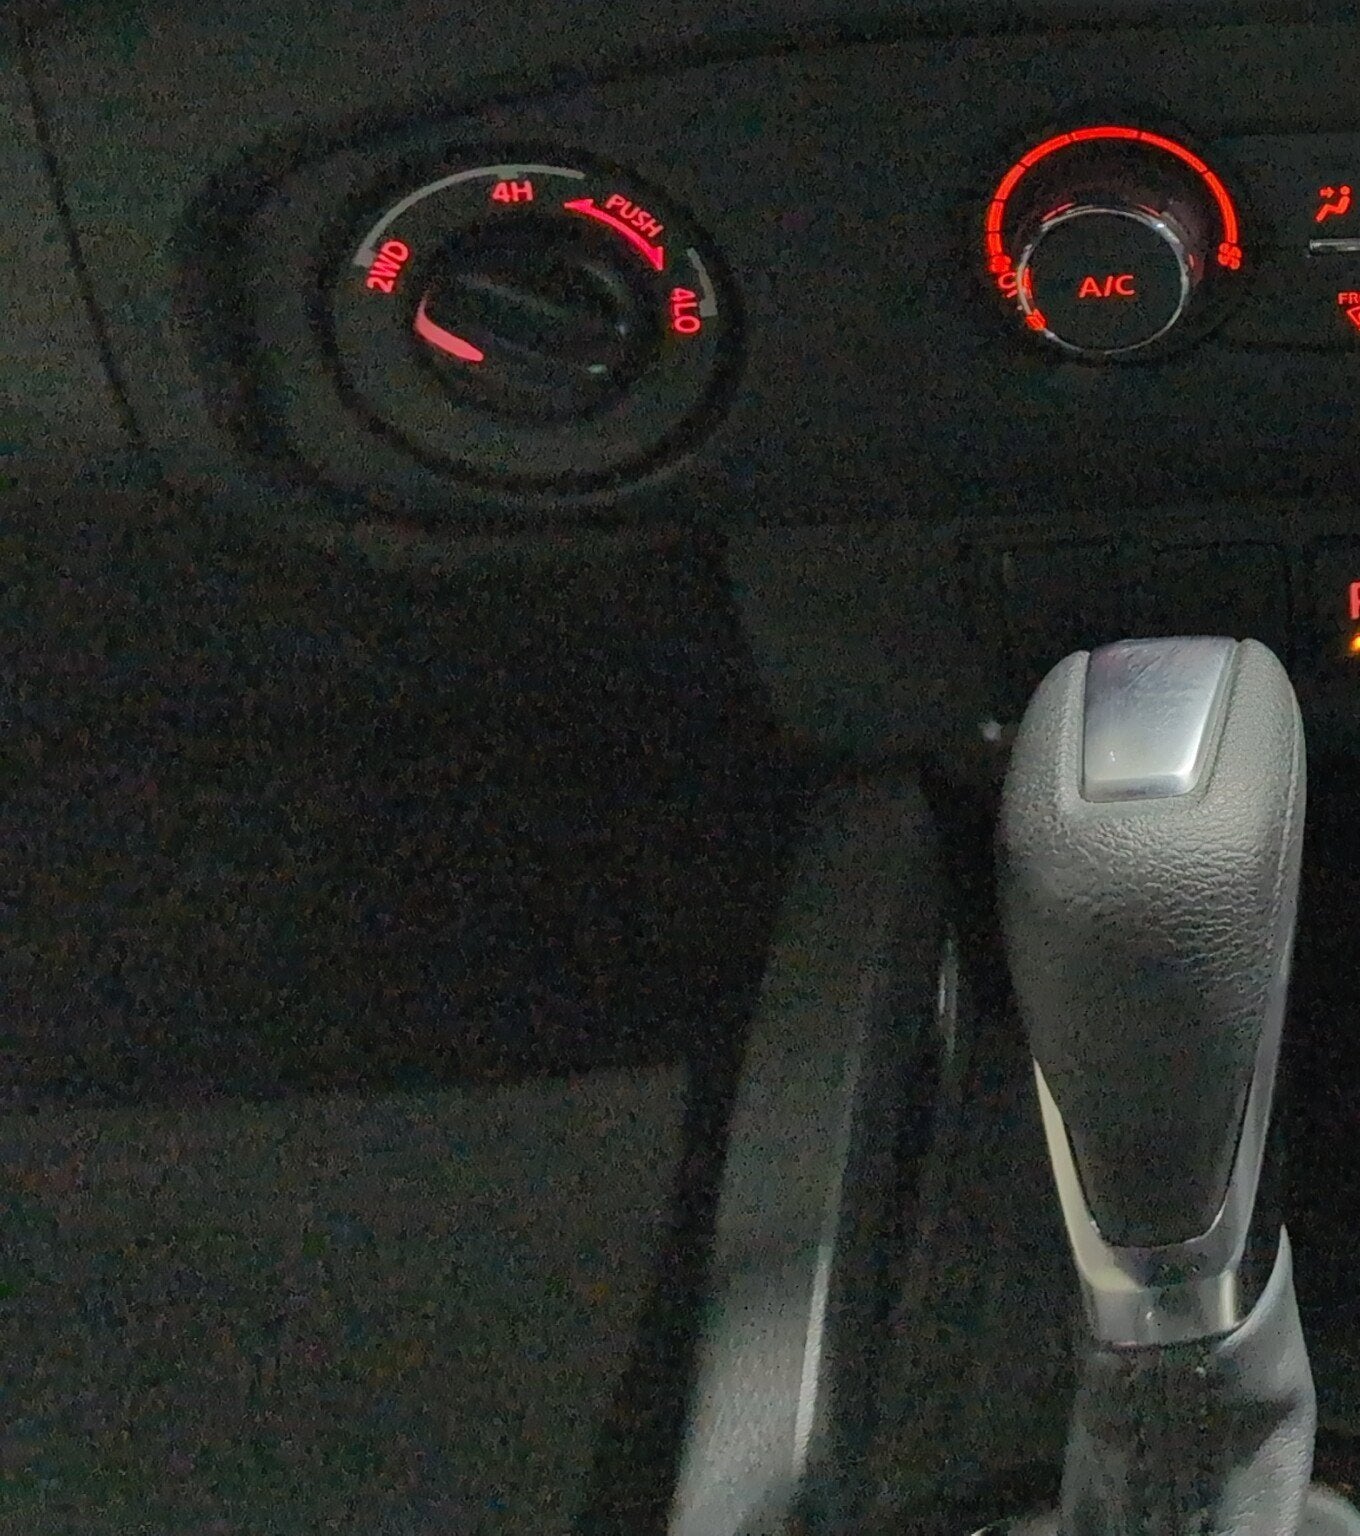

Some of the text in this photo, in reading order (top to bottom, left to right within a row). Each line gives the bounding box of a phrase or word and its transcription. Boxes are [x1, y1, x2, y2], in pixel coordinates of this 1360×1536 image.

[491, 180, 534, 203] 4H
[605, 193, 664, 239] PUSH
[366, 240, 410, 293] 2WD
[1079, 275, 1135, 297] A/C
[669, 287, 701, 333] 4LO
